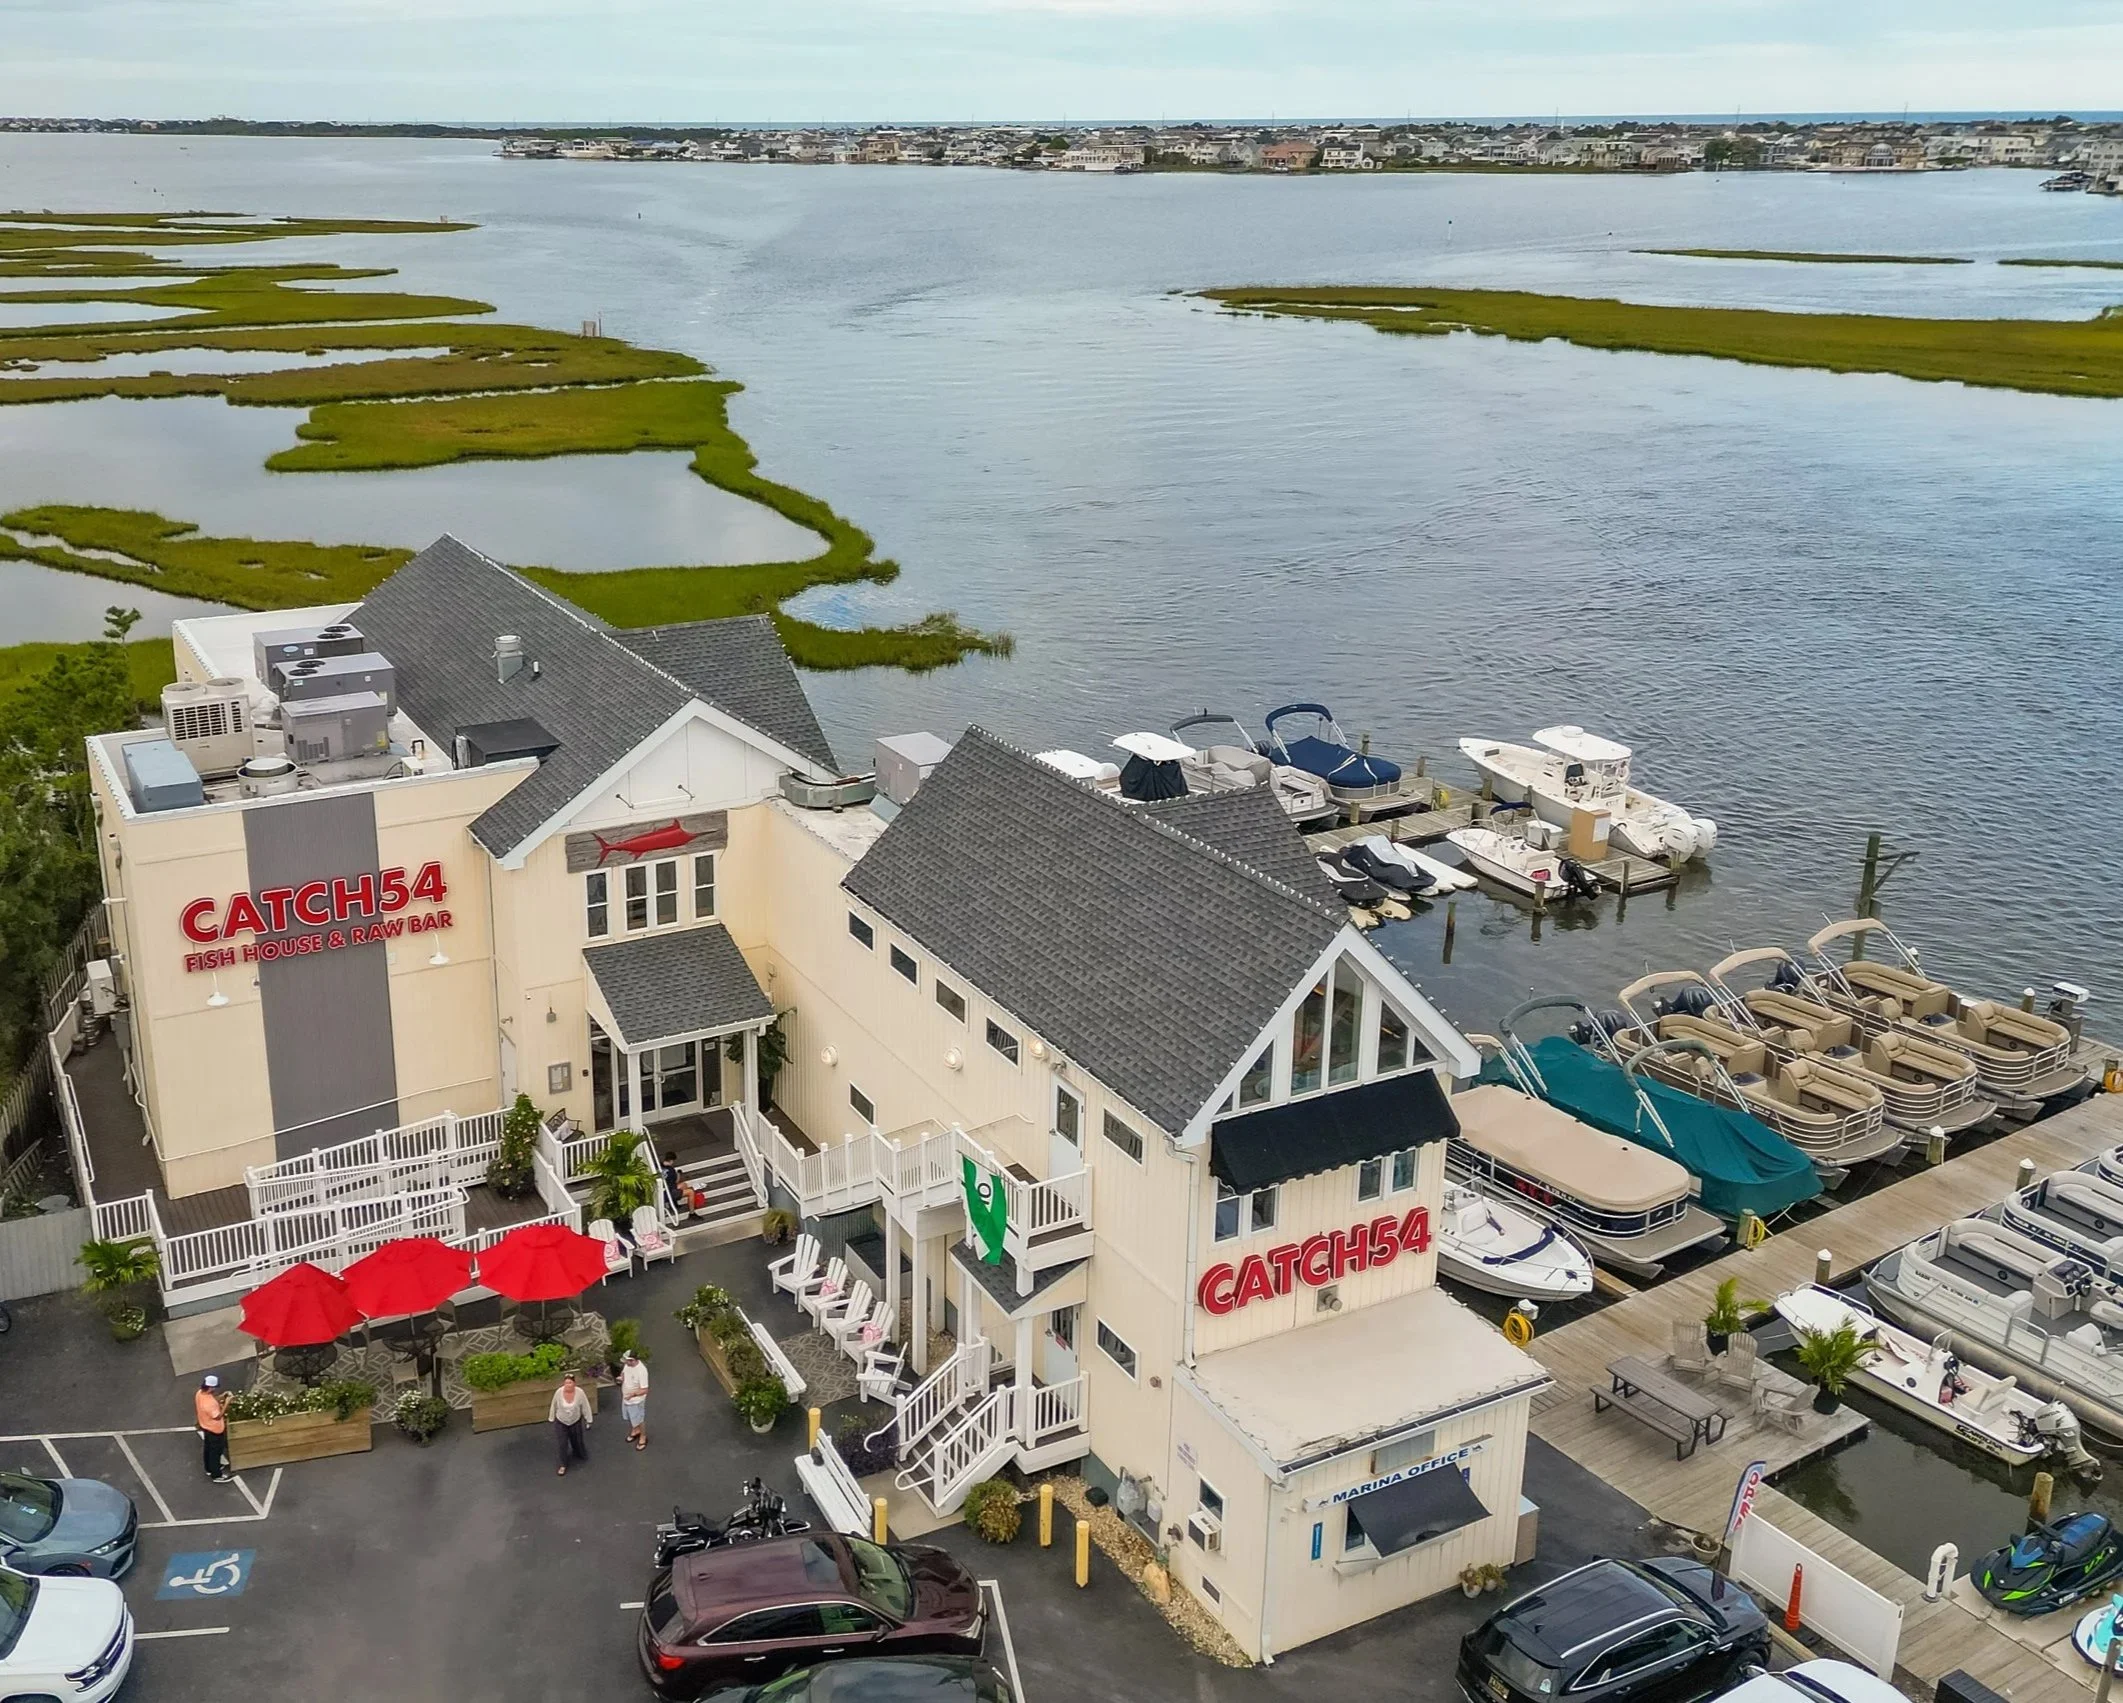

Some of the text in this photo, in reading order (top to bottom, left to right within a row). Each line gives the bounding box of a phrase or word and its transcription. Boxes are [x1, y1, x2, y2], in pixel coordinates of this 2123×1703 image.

[179, 861, 448, 944] CATCH54
[184, 910, 453, 973] FISH HOUSE & RAW BAR
[1197, 1205, 1432, 1317] CATCH54
[1332, 1473, 1402, 1503] MARINA
[1407, 1447, 1469, 1477] OFFICE
